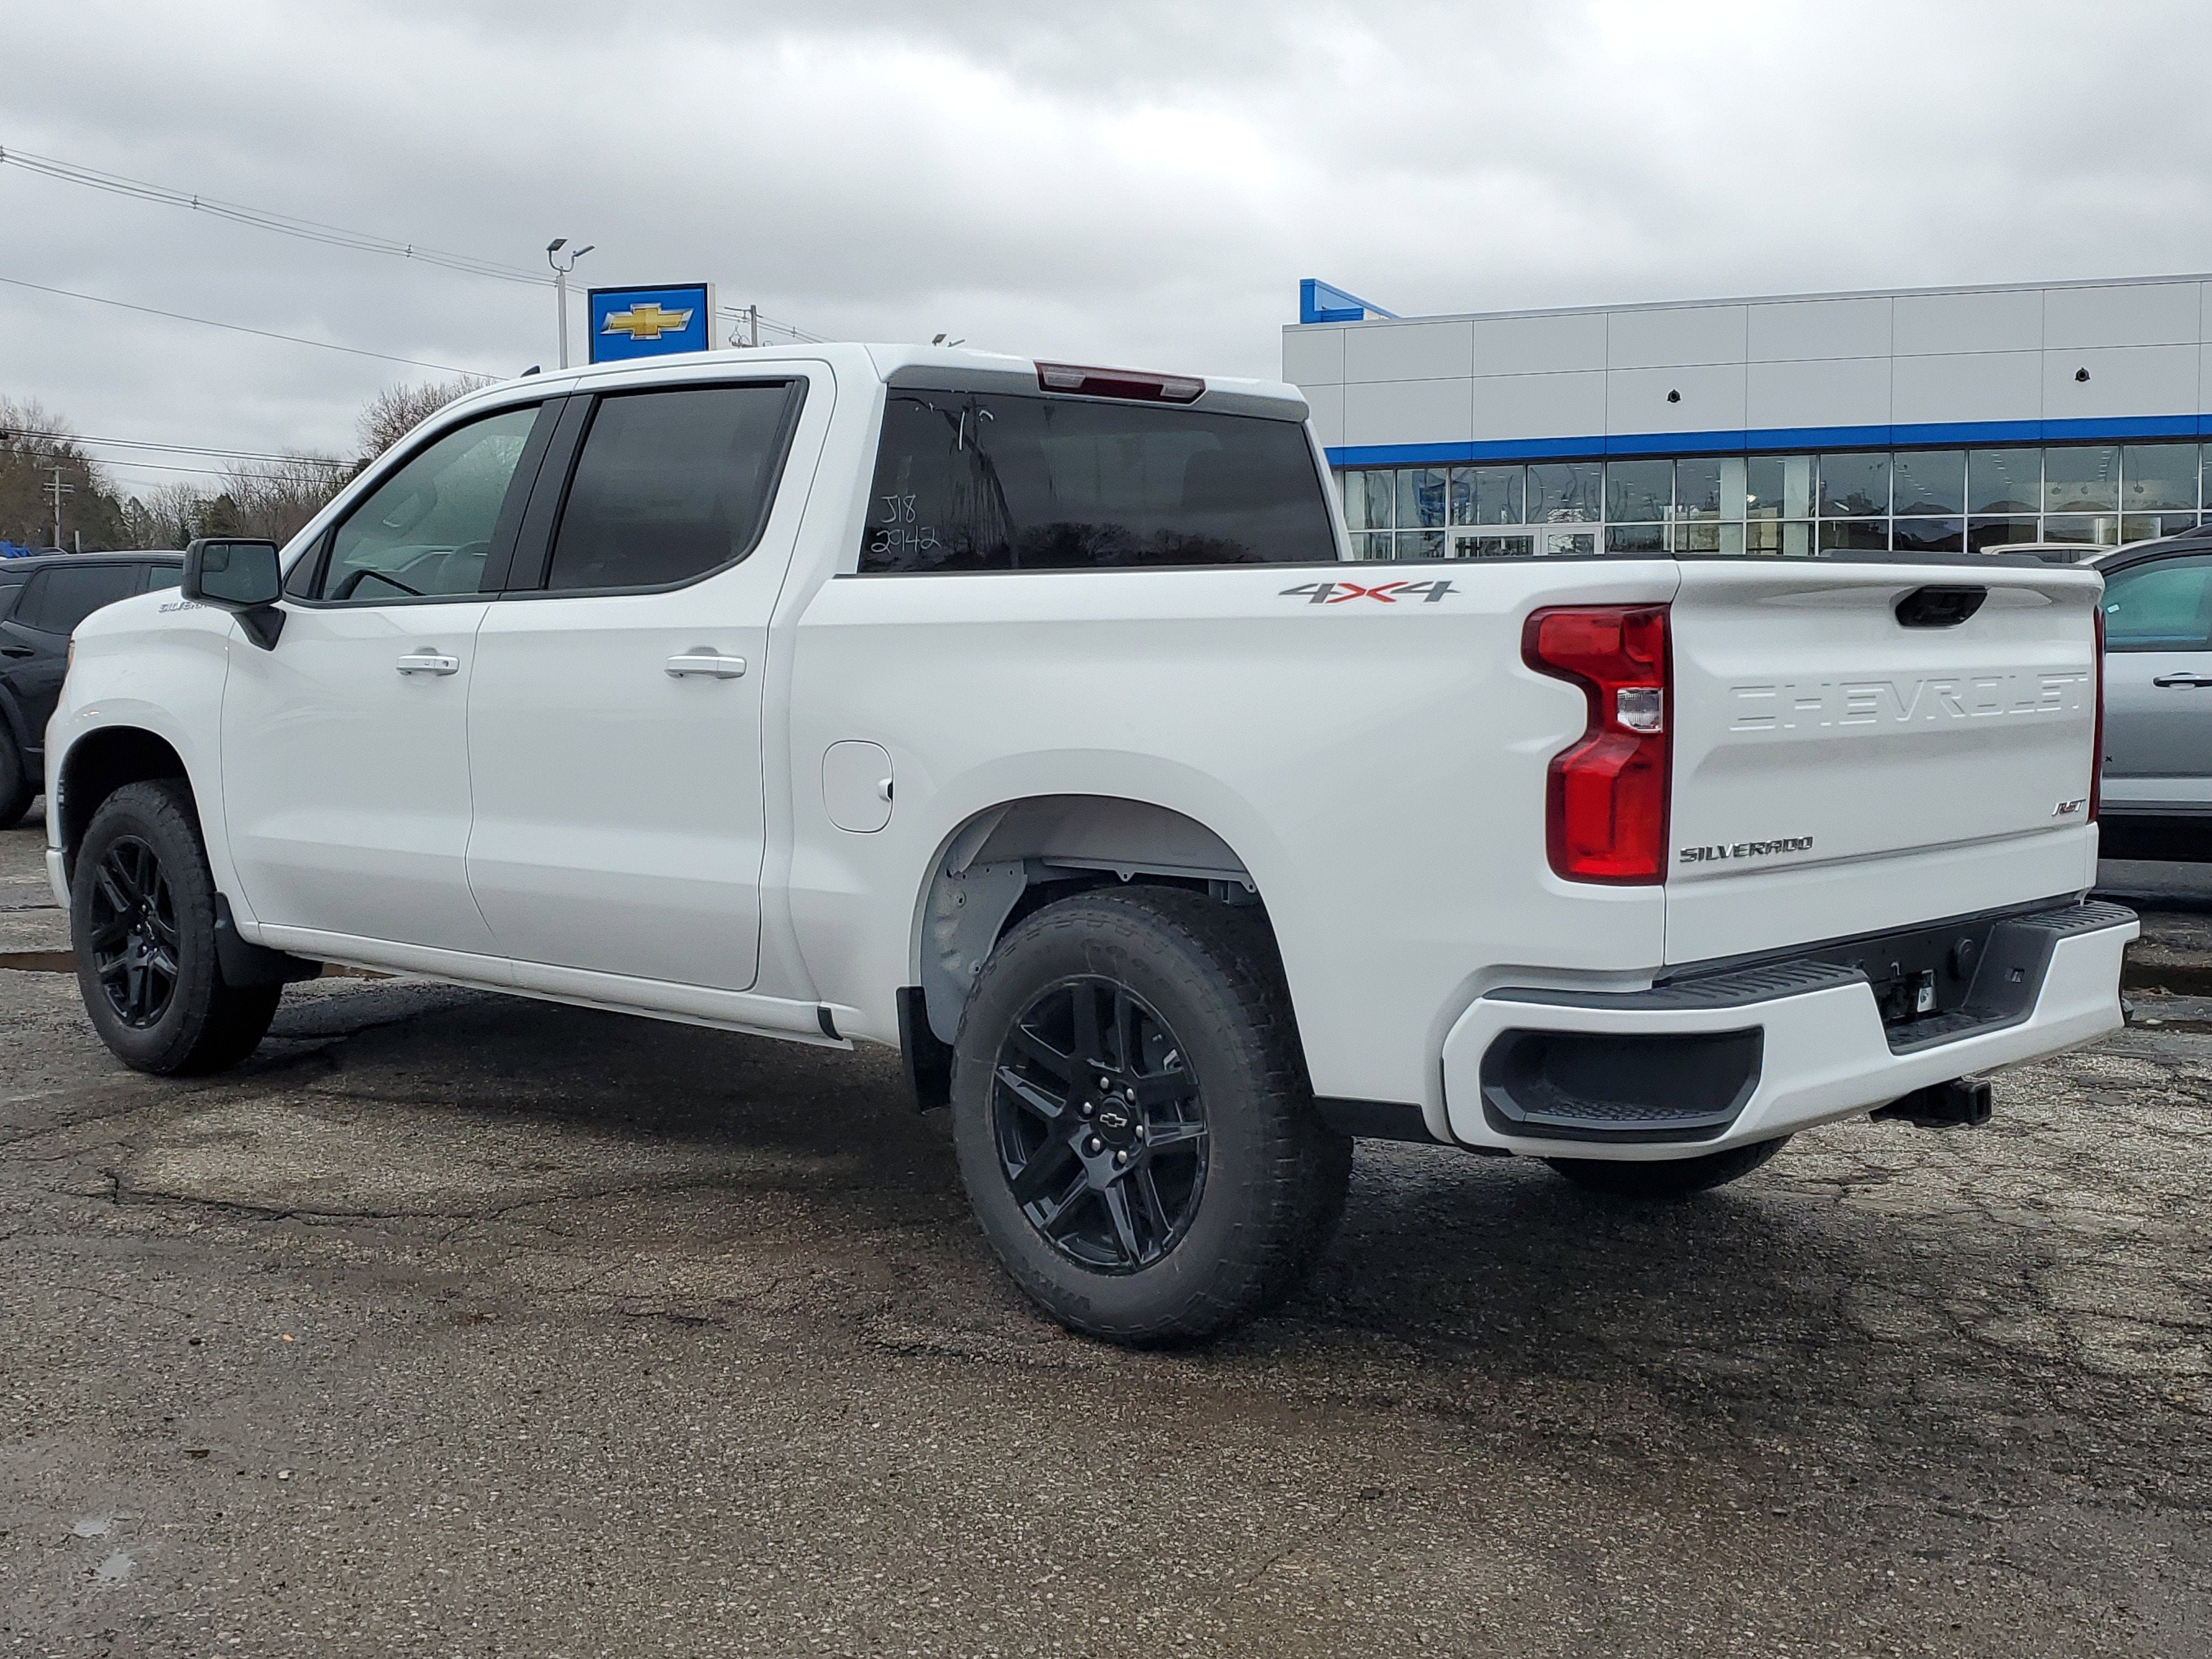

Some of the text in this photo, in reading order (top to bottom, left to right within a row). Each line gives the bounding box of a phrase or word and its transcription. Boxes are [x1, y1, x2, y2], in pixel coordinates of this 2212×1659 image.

[1729, 672, 2088, 731] CHEVROLET
[2051, 798, 2086, 816] RST
[1679, 836, 1813, 862] SILVERADO
